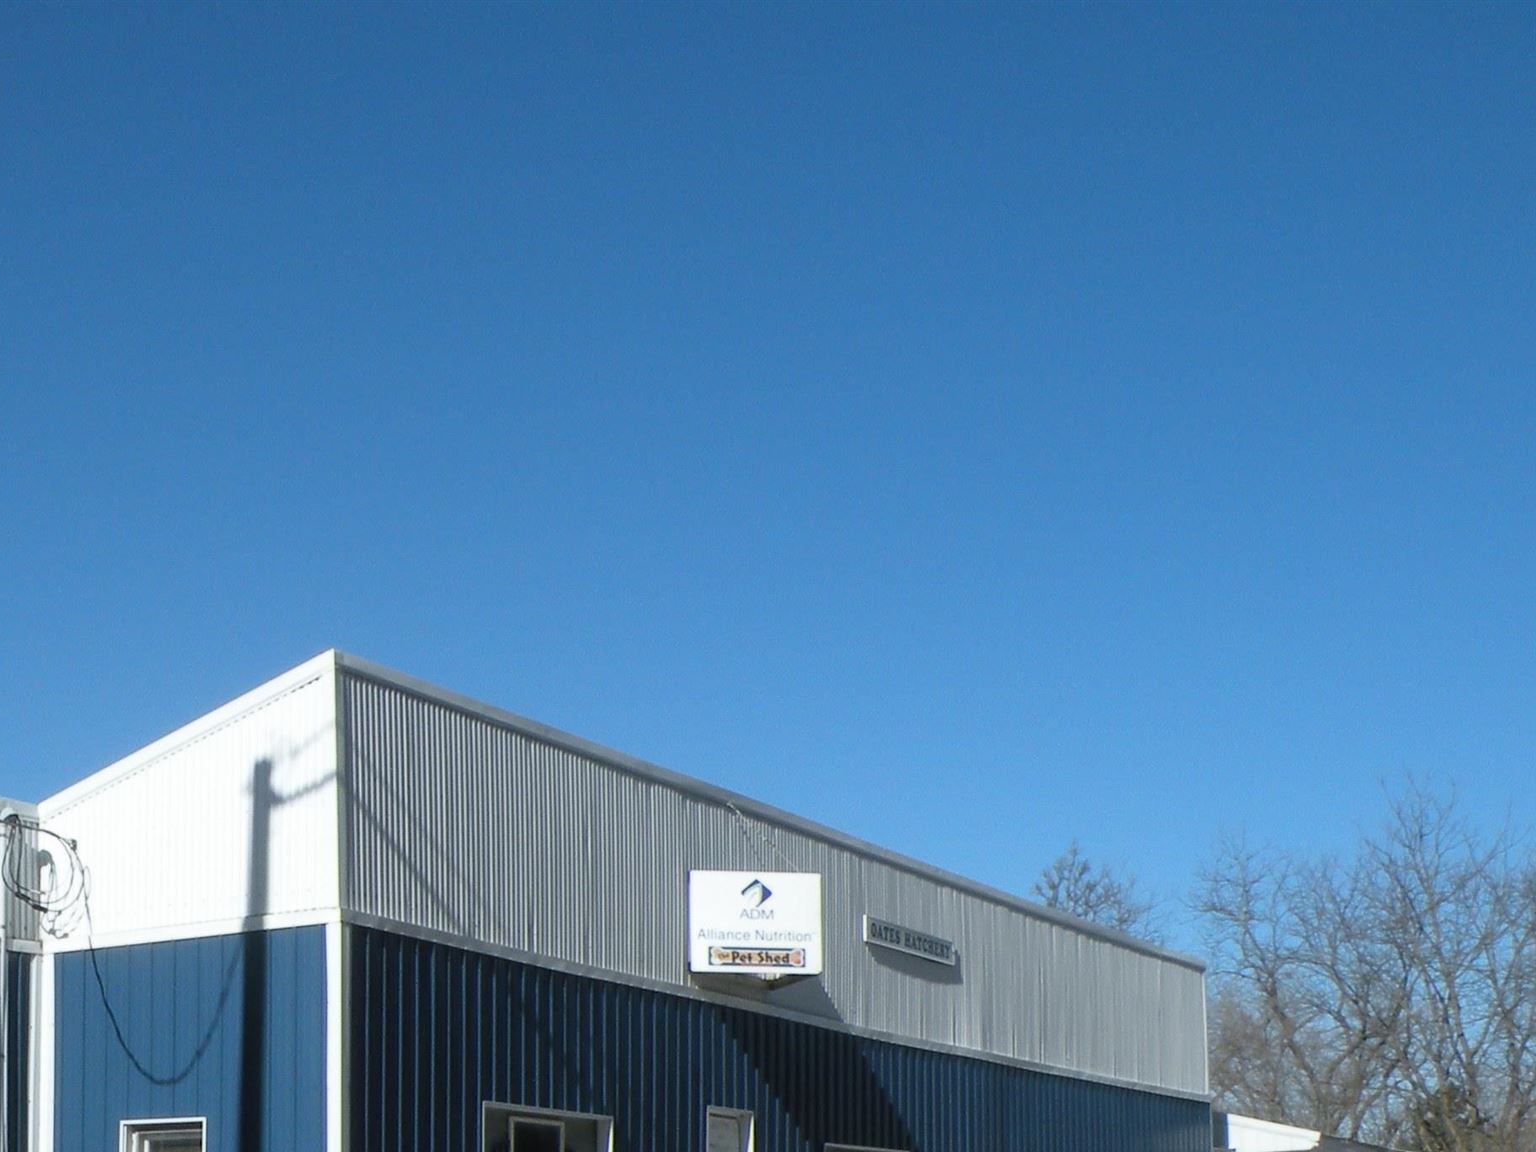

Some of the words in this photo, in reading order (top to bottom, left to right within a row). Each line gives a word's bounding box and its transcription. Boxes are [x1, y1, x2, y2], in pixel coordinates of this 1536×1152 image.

[739, 908, 775, 920] ADM
[698, 928, 751, 942] Alliance
[755, 930, 812, 942] Nutrition
[869, 922, 901, 945] OATES
[904, 932, 951, 958] HATCHERY
[732, 951, 753, 962] Pet
[758, 952, 790, 964] Shed
